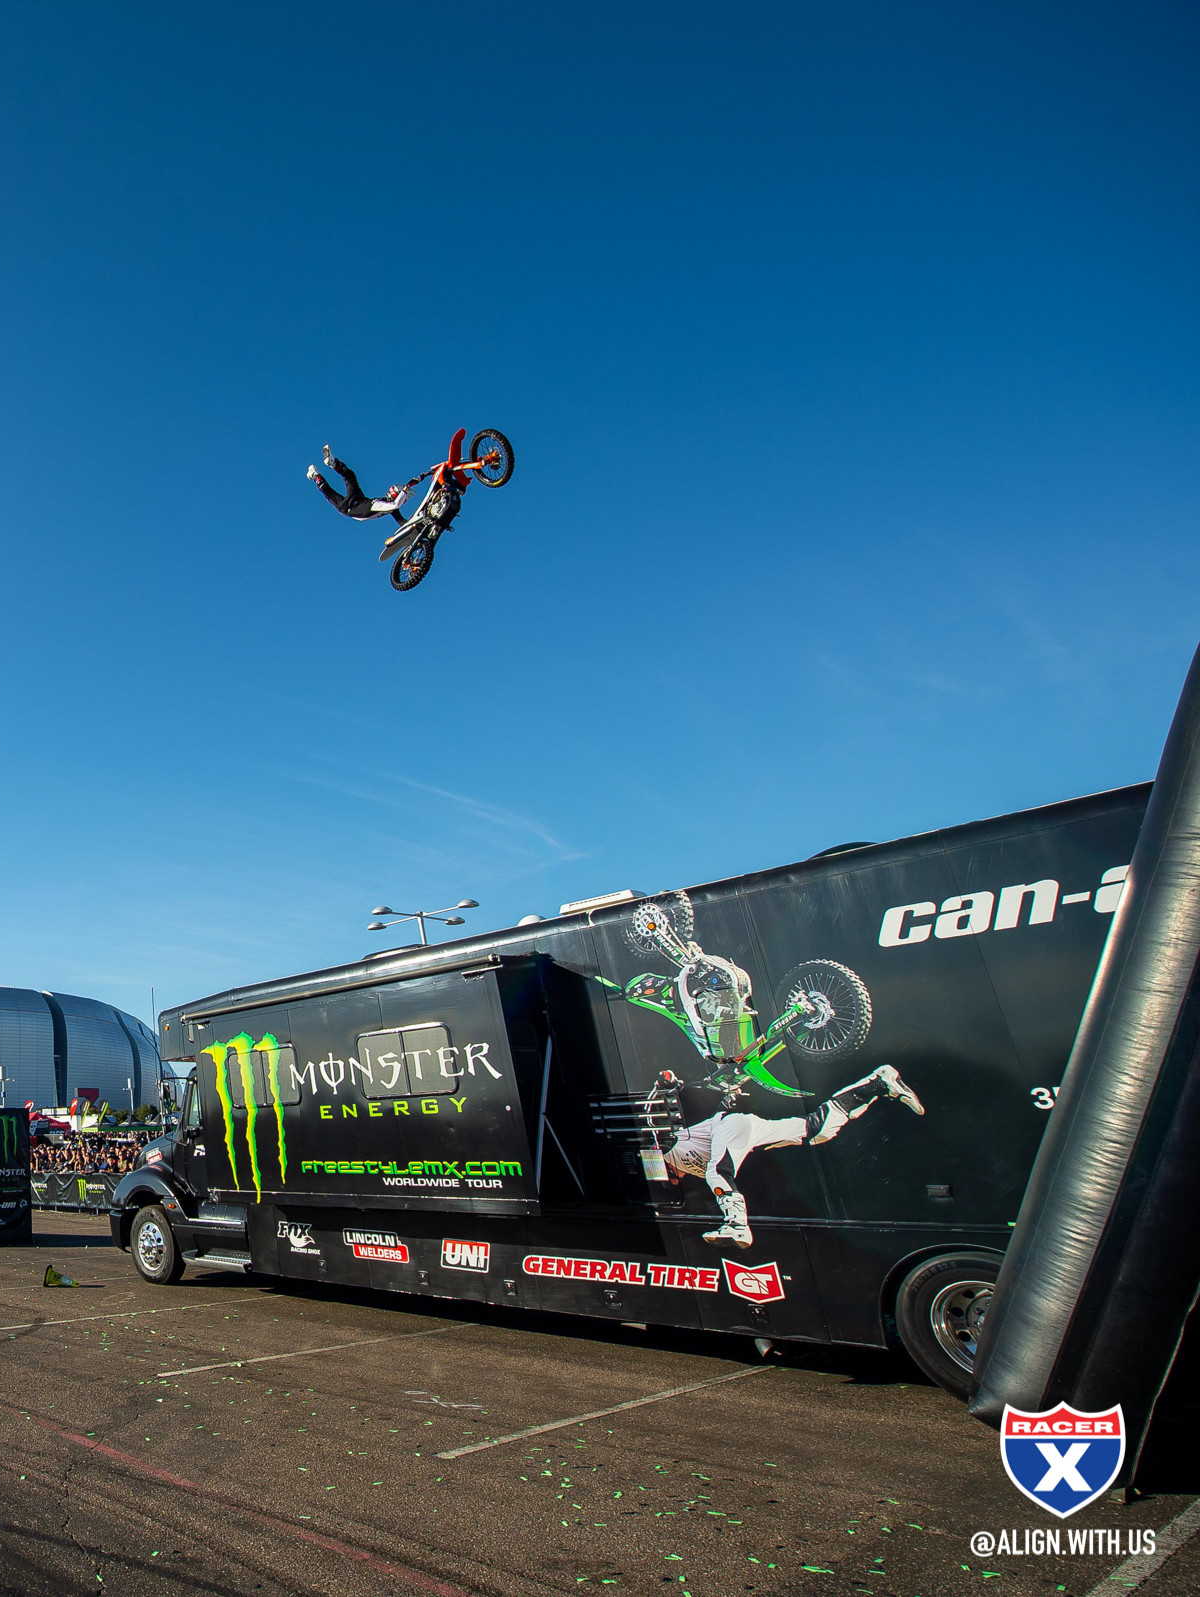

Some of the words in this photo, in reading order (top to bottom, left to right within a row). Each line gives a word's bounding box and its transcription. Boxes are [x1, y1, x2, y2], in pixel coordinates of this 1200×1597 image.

[289, 1042, 503, 1095] MONSTER
[320, 1097, 467, 1119] ENERGY
[382, 1177, 460, 1187] WORLDWIDE
[465, 1179, 503, 1188] TOUR
[277, 1221, 312, 1239] FOX
[346, 1231, 396, 1247] LINCOLN
[358, 1246, 402, 1260] WELDERS
[445, 1242, 485, 1268] UNI
[523, 1256, 645, 1284] GENERAL
[648, 1265, 719, 1290] TIRE
